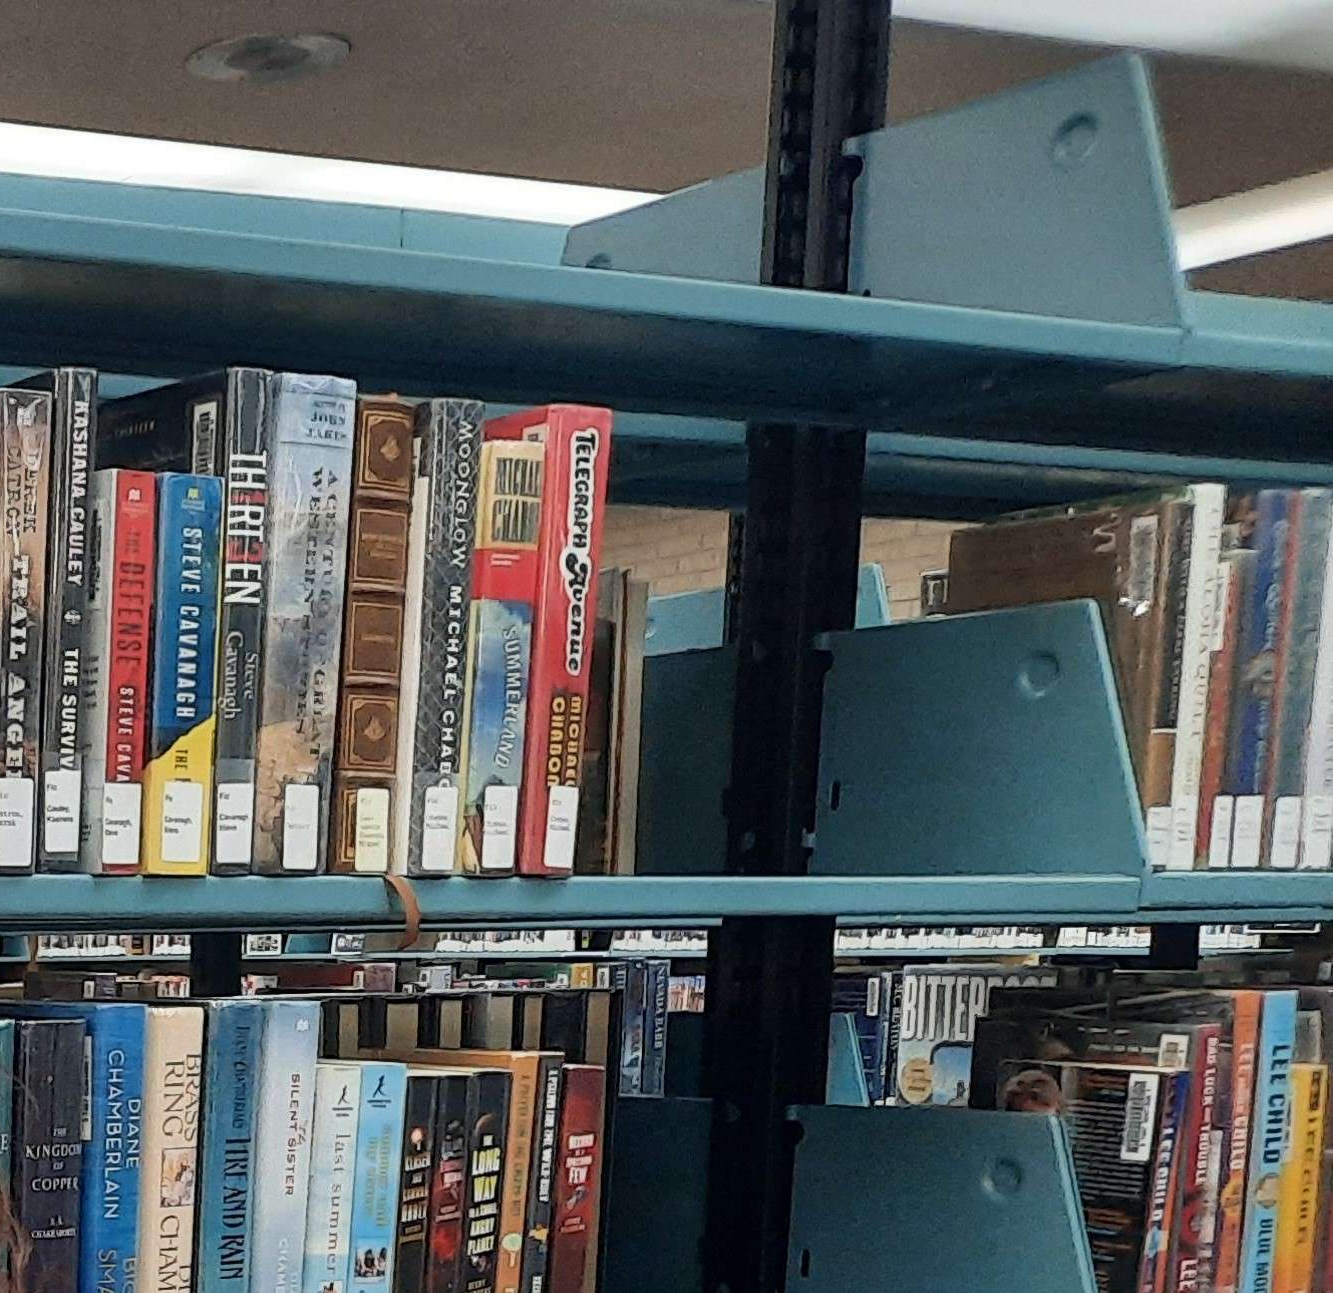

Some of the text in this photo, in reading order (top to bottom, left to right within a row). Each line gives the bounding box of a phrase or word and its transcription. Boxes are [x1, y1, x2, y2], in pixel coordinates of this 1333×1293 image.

[65, 400, 91, 588] KASHANA CAULEY
[449, 419, 476, 571] MOONGLOW
[570, 430, 598, 551] TELEGRAPH
[7, 554, 31, 661] TRAIL
[116, 560, 147, 669] DEFENSE
[173, 526, 205, 722] STEVE CAVANAGH
[441, 584, 465, 700] MICHAEL
[62, 647, 81, 687] THE
[117, 686, 136, 727] STEVE
[219, 630, 244, 721] Cavanagh
[492, 623, 524, 770] SUMMERLAND
[101, 1048, 127, 1221] CHAMBERLAIN
[123, 1098, 143, 1171] DIANE
[161, 1060, 186, 1138] RING
[183, 1053, 204, 1143] BRASS
[283, 1072, 302, 1198] SILENT SISTER
[1261, 1044, 1292, 1165] LEE CHILD
[30, 1177, 81, 1193] COPPER
[470, 1147, 503, 1176] LONG
[472, 1175, 500, 1203] WAY
[324, 1182, 346, 1275] summer
